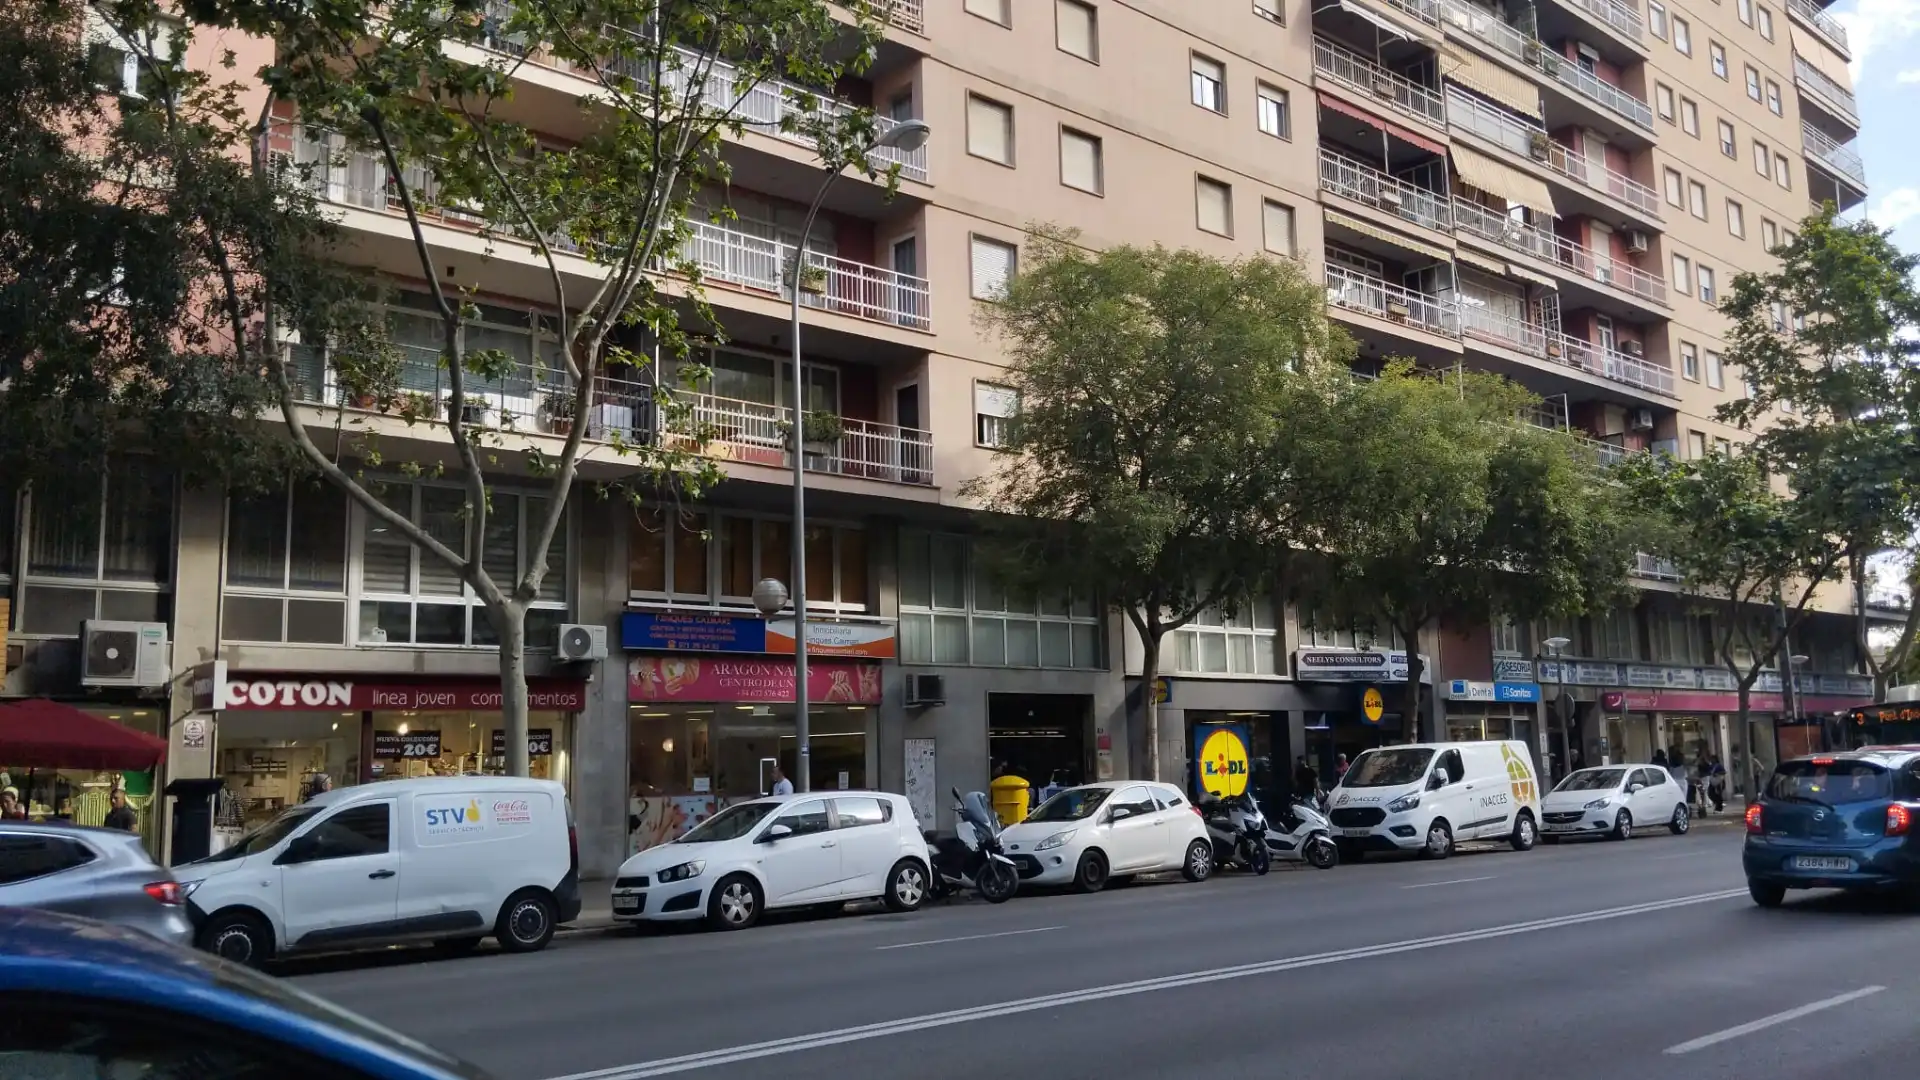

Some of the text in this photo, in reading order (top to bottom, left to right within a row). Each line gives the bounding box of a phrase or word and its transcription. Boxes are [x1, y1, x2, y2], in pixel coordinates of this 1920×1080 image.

[1335, 656, 1381, 664] CONSULTORS
[774, 665, 814, 677] NAIS
[719, 677, 763, 687] CENTRO
[763, 679, 777, 688] DE
[225, 680, 353, 706] COTON
[1472, 687, 1493, 697] Dental
[1509, 688, 1532, 698] Sanitas
[412, 690, 456, 709] joven
[471, 692, 577, 706] commentos
[1856, 712, 1865, 725] 3
[403, 743, 437, 756] 20€
[528, 741, 549, 753] 0€
[1480, 793, 1508, 808] INACCES
[426, 807, 465, 826] STV
